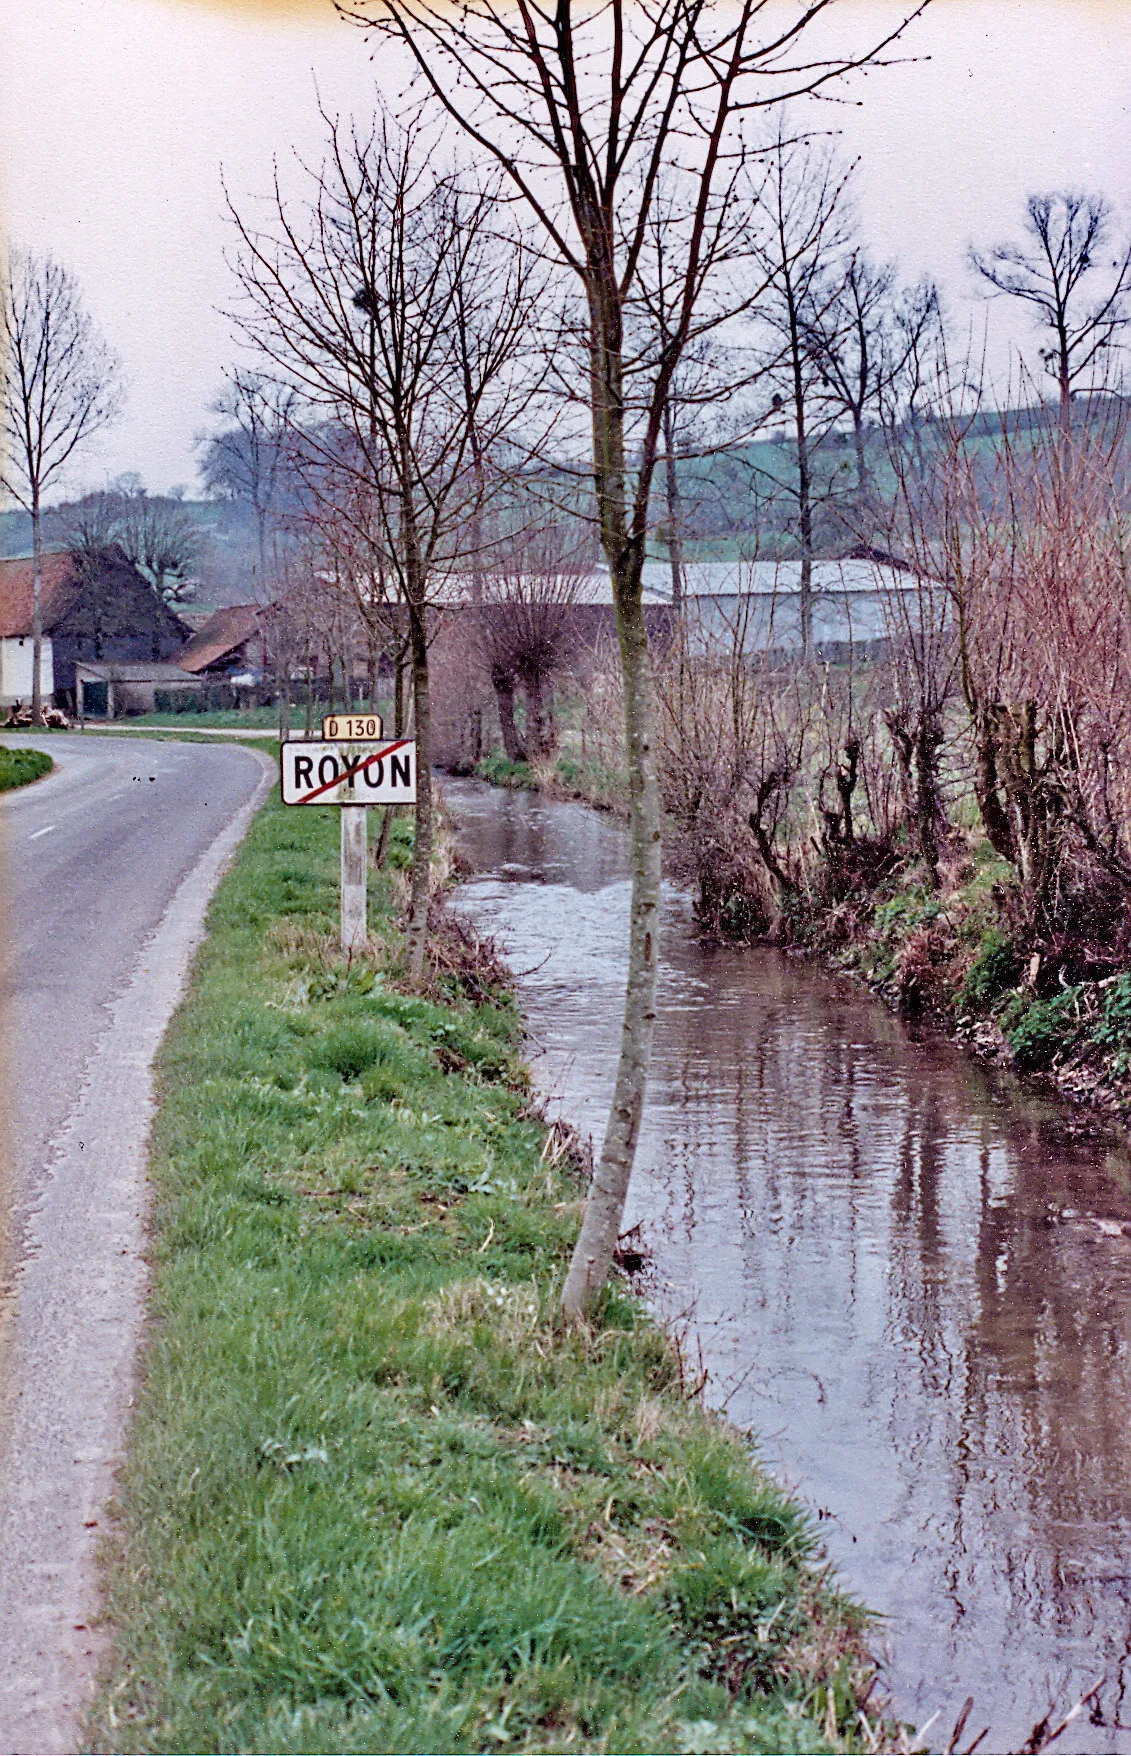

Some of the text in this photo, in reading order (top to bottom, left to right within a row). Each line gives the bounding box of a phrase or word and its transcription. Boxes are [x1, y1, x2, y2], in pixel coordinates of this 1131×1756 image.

[329, 719, 376, 737] D 130
[294, 755, 411, 789] ROYON
